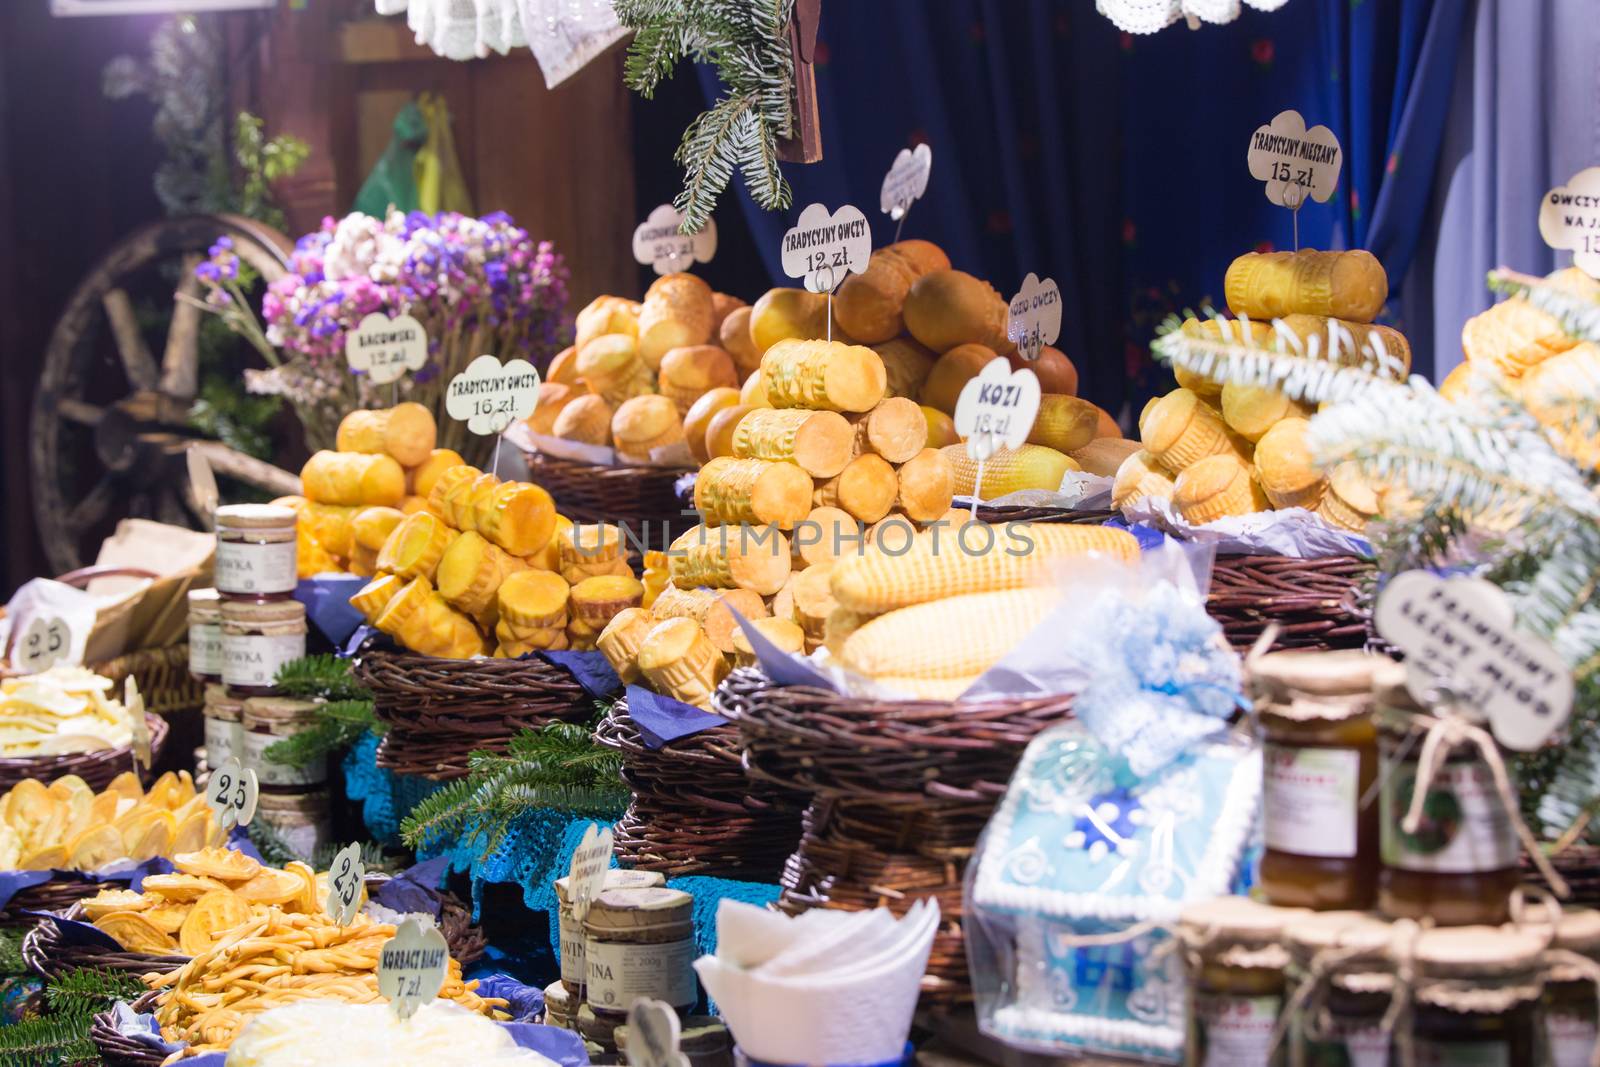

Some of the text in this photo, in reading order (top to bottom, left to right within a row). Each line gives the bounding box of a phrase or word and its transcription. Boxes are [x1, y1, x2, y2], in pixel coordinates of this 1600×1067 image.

[1254, 132, 1338, 165] TRADYCYJNY MIESZANY
[1271, 161, 1316, 188] 15 zł.
[1565, 215, 1584, 227] NA
[786, 219, 865, 252] TRADYCYJNY OWCZY
[806, 246, 852, 272] 12 zł.
[453, 373, 536, 396] TRADYCYJNY OWCZY
[979, 384, 1021, 406] KOZI
[473, 399, 493, 415] 16
[397, 976, 405, 997] 7
